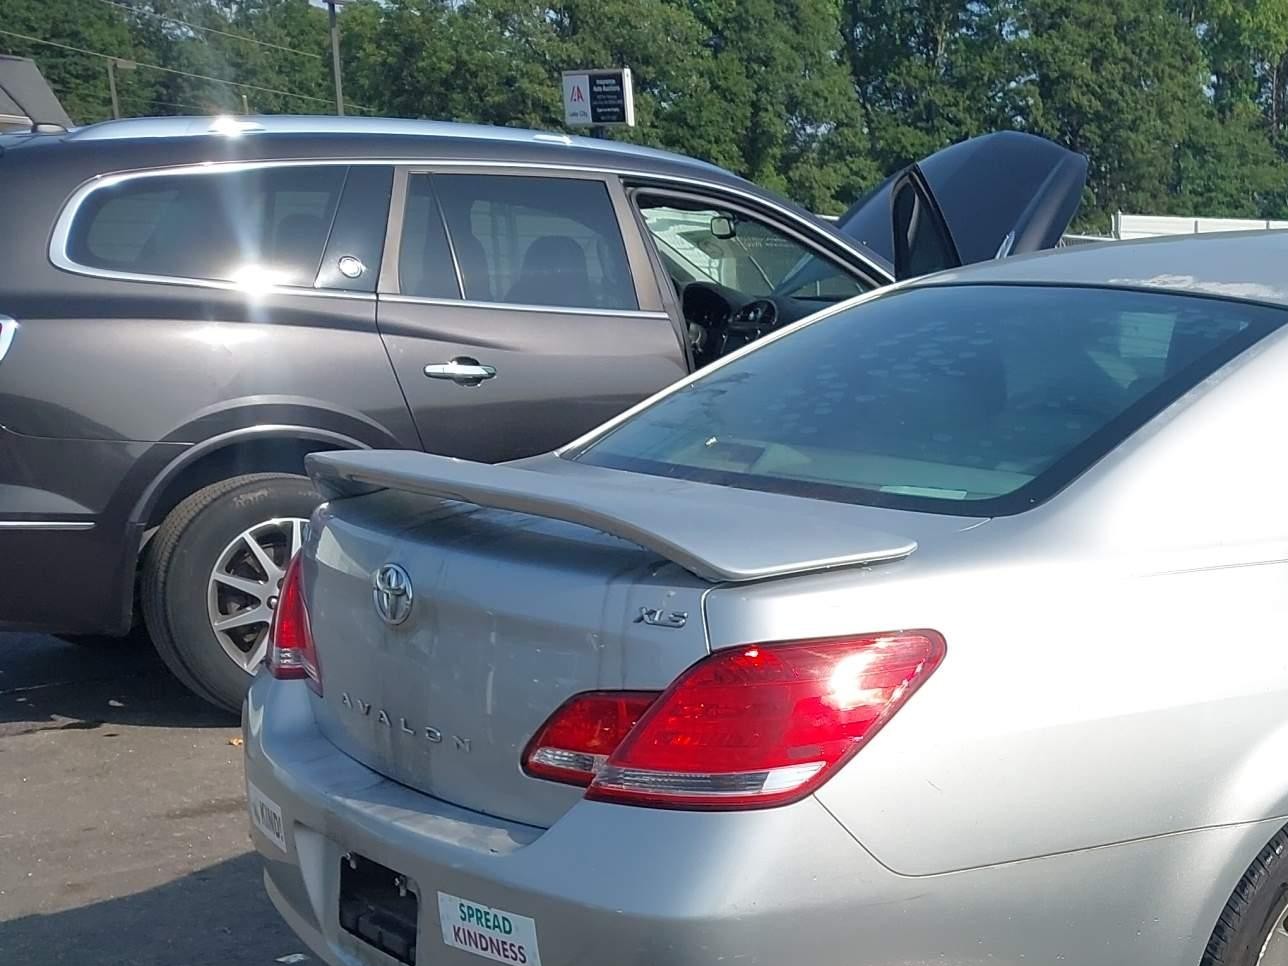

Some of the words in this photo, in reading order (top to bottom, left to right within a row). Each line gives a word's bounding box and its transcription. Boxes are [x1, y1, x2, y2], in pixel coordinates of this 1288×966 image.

[633, 606, 688, 628] XLS
[342, 690, 472, 753] AVALON
[459, 903, 513, 935] SPREAD
[452, 925, 527, 964] KINDNESS
